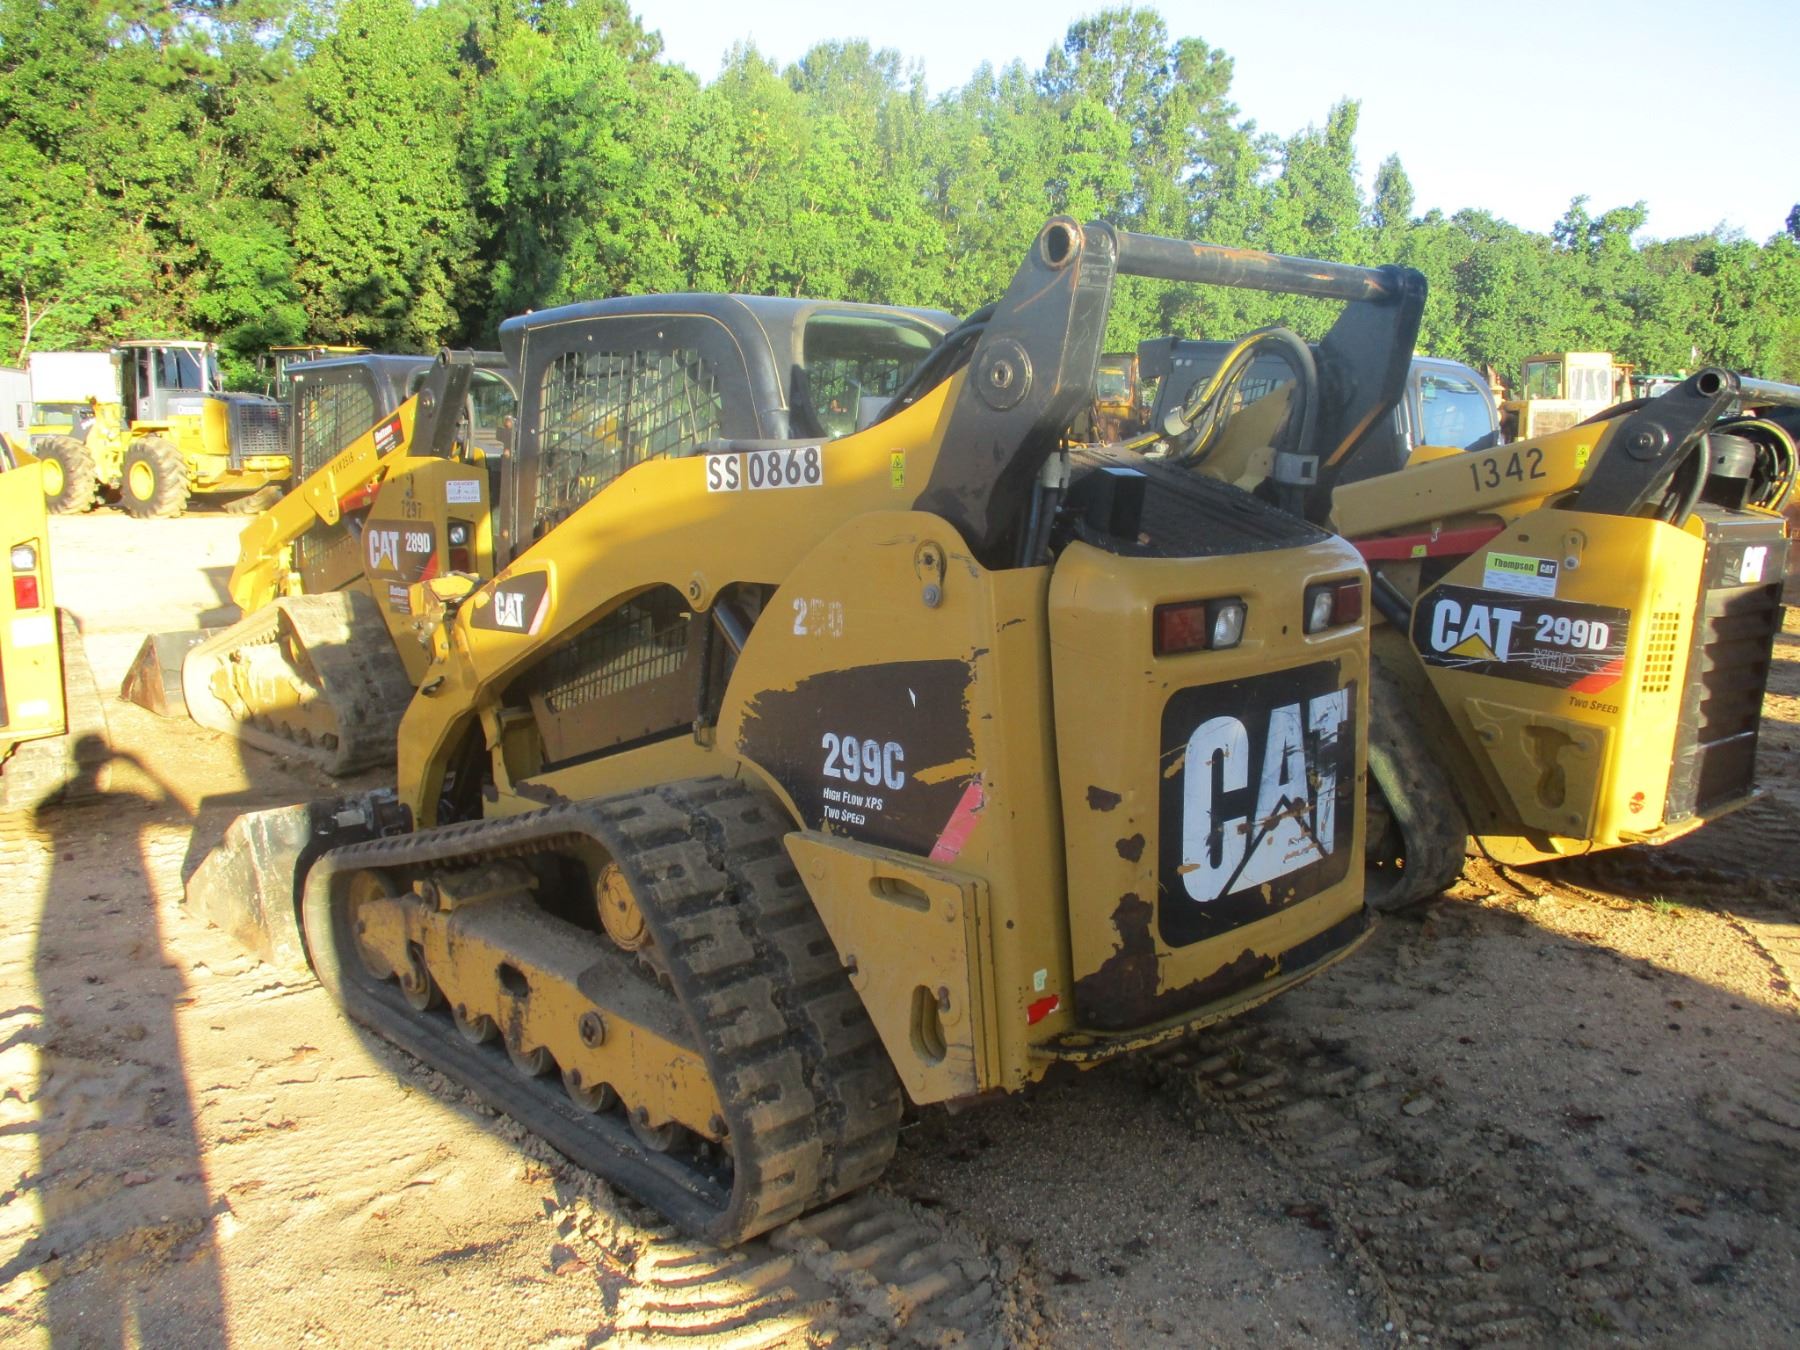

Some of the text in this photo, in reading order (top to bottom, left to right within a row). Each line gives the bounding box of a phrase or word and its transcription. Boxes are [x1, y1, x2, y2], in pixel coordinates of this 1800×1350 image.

[708, 447, 821, 490] SS 0868
[1470, 448, 1547, 492] 1342
[369, 529, 431, 571] CAT 289D
[1494, 557, 1556, 574] Thompson CAT
[494, 591, 526, 628] CAT
[1430, 598, 1609, 664] CAT 299D
[822, 732, 905, 791] 299C
[865, 796, 883, 811] XPS
[1182, 687, 1349, 903] CAT
